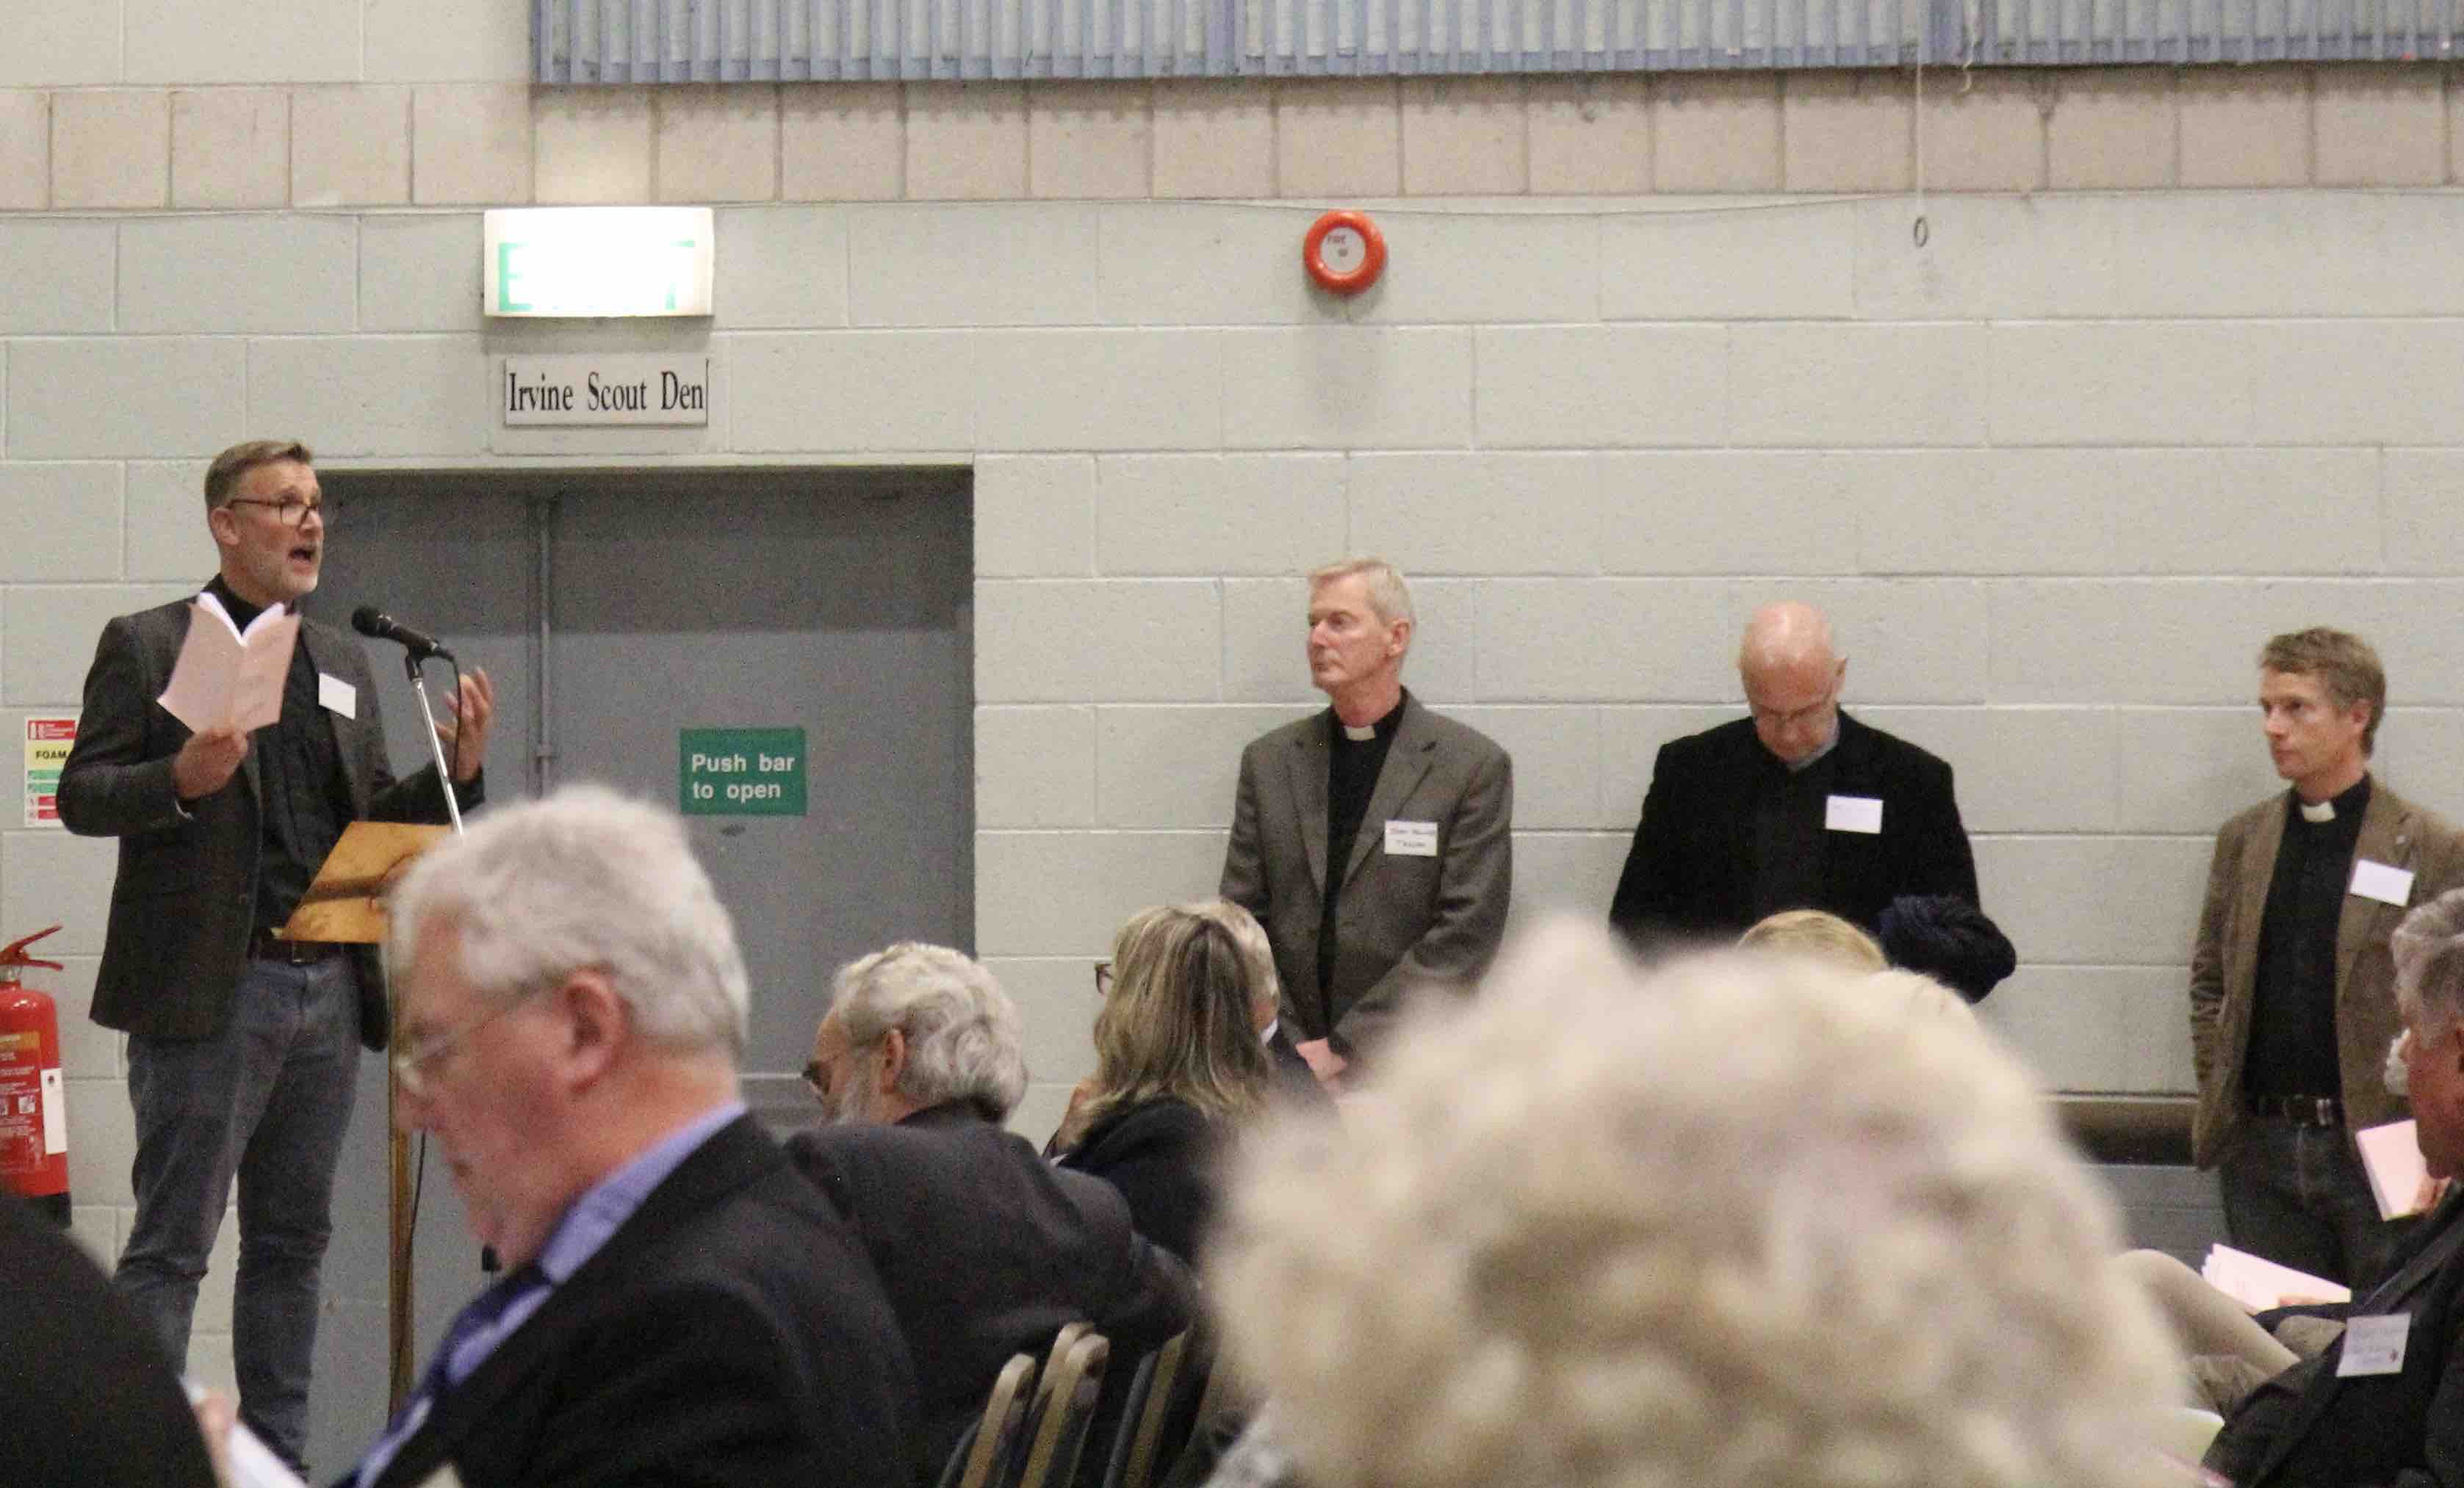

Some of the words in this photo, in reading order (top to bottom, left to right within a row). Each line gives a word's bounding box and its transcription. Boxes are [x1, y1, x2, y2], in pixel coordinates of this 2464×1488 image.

[509, 372, 574, 412] Irvine
[588, 371, 647, 411] Scout
[660, 370, 704, 411] Den
[36, 750, 67, 759] FOAM
[691, 754, 747, 773] Push
[759, 753, 796, 772] bar
[693, 781, 714, 799] to
[727, 784, 781, 804] open
